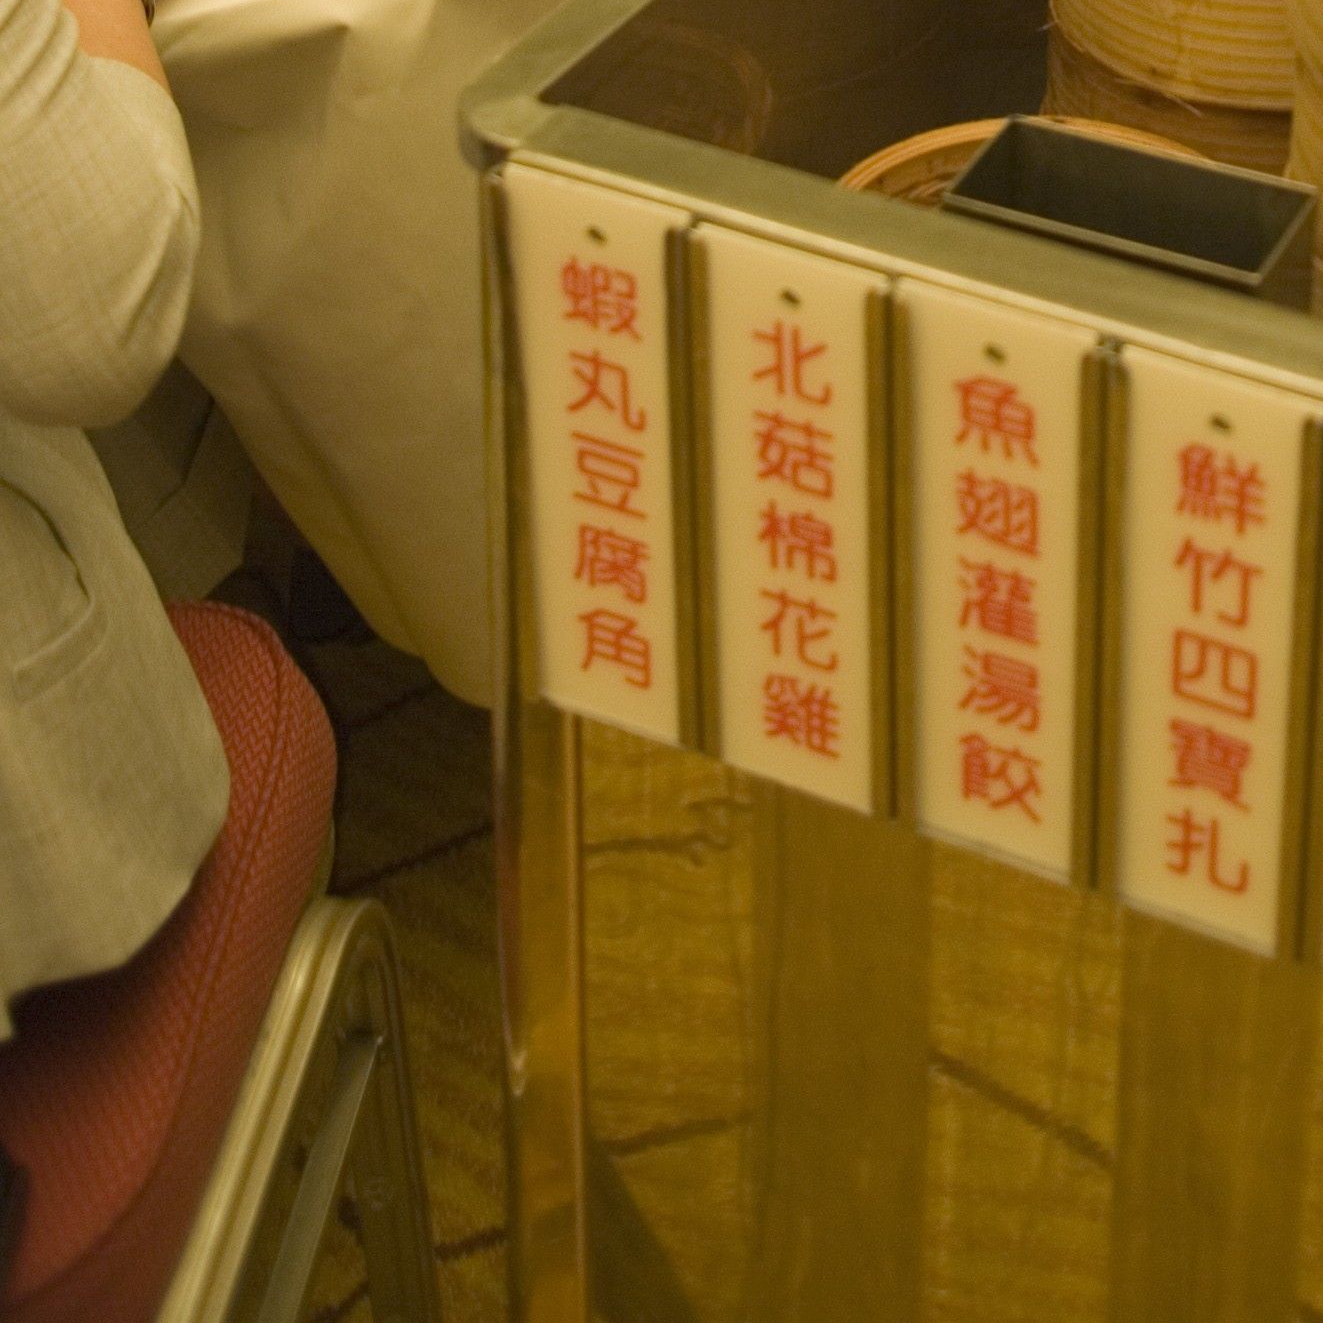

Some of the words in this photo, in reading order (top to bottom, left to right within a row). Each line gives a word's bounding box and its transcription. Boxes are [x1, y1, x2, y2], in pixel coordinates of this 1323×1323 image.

[558, 256, 653, 691] 蝦丸豆腐角
[752, 320, 841, 760] 北菇棉花雞
[953, 376, 1043, 824] 魚翅灌湯餃
[1166, 442, 1266, 897] 鮮竹四寶扎
